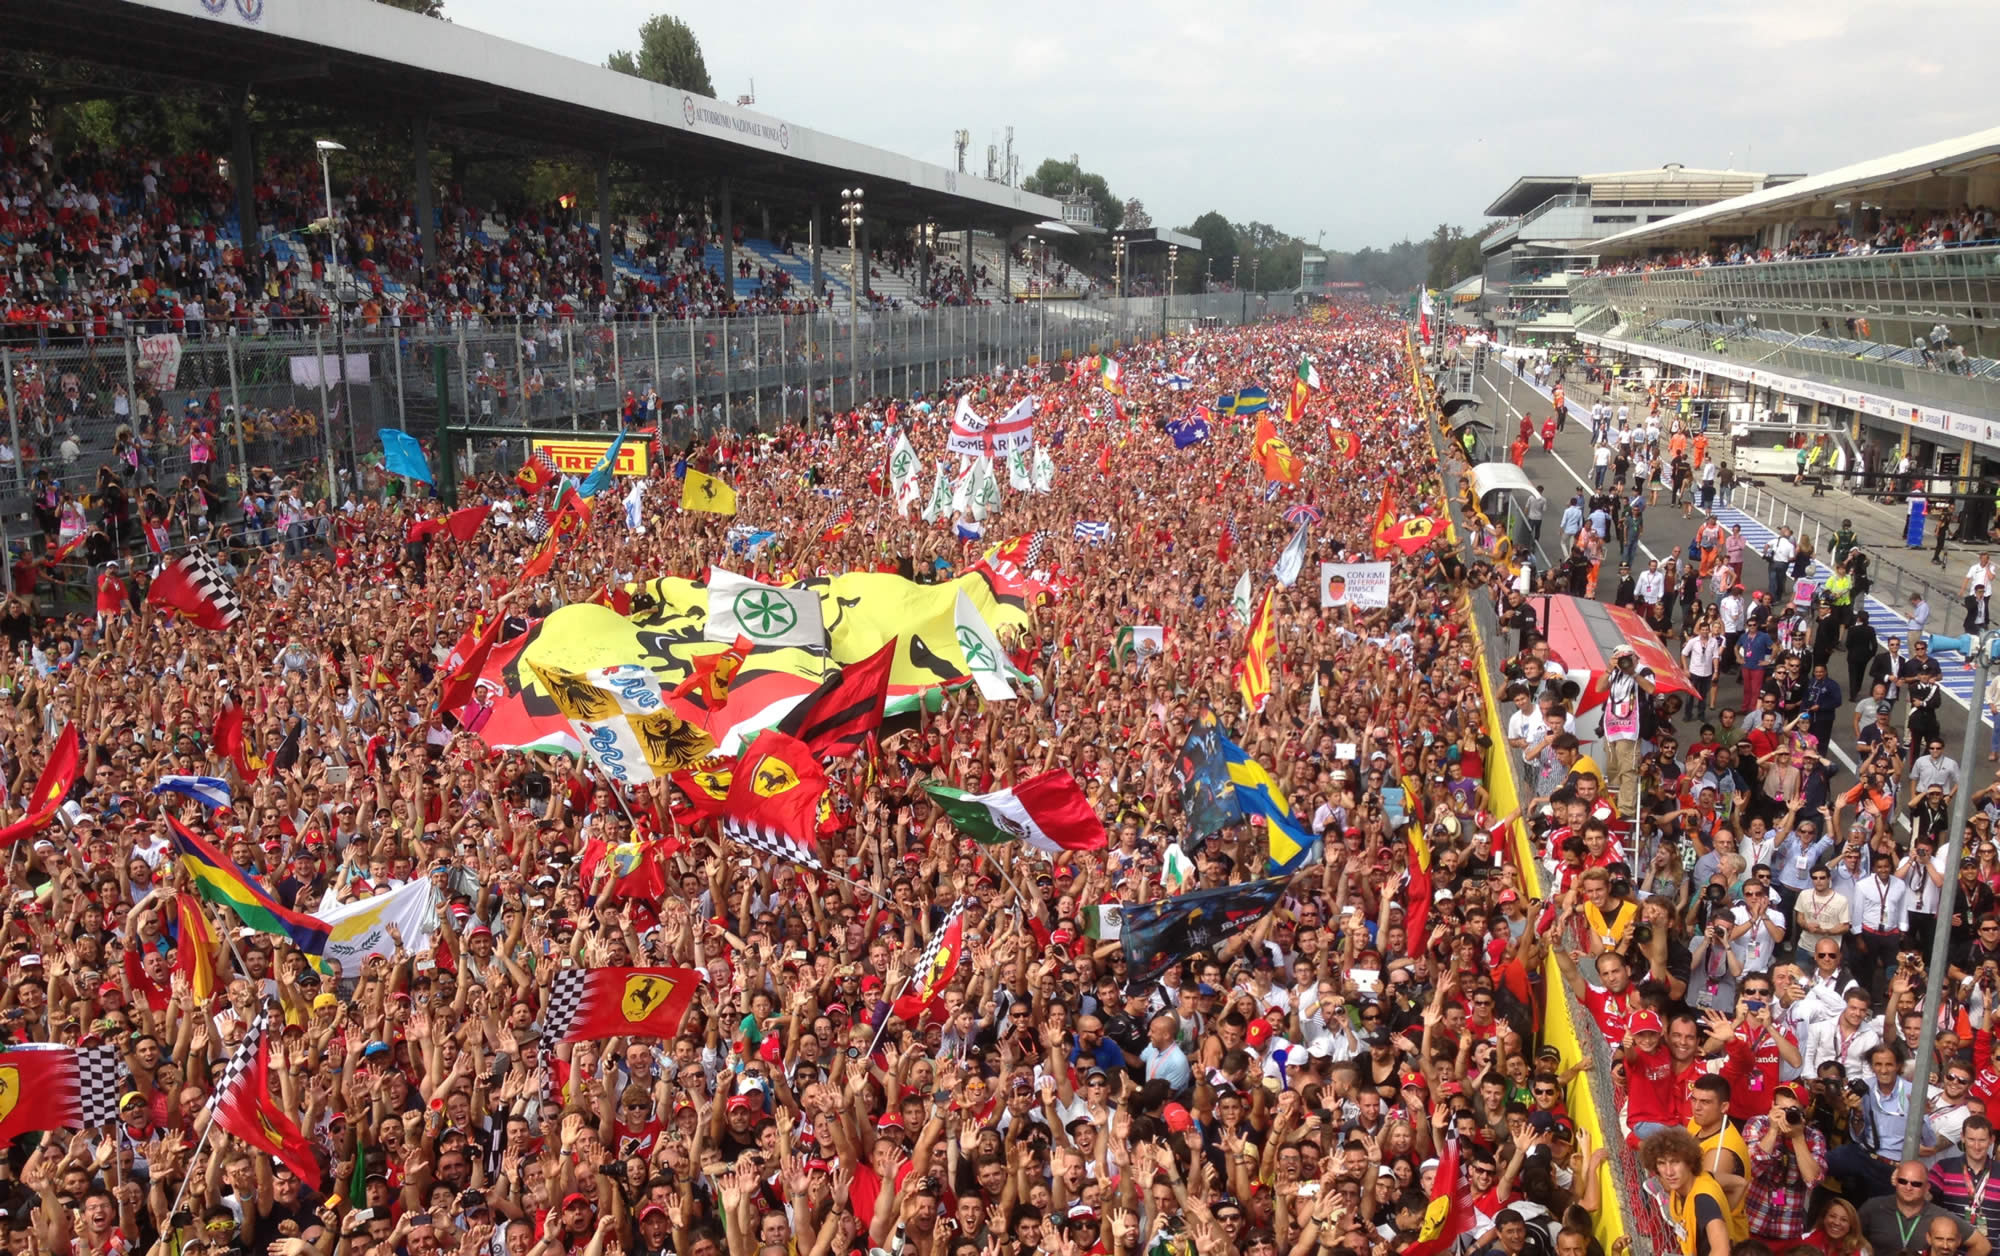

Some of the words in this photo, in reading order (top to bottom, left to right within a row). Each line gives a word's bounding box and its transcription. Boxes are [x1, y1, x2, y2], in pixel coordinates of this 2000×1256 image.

[696, 108, 732, 128] AUTODROMO
[732, 117, 761, 136] NAZIONALE
[762, 125, 780, 142] MONZA
[1347, 571, 1365, 579] CON
[1367, 571, 1385, 579] KIMI
